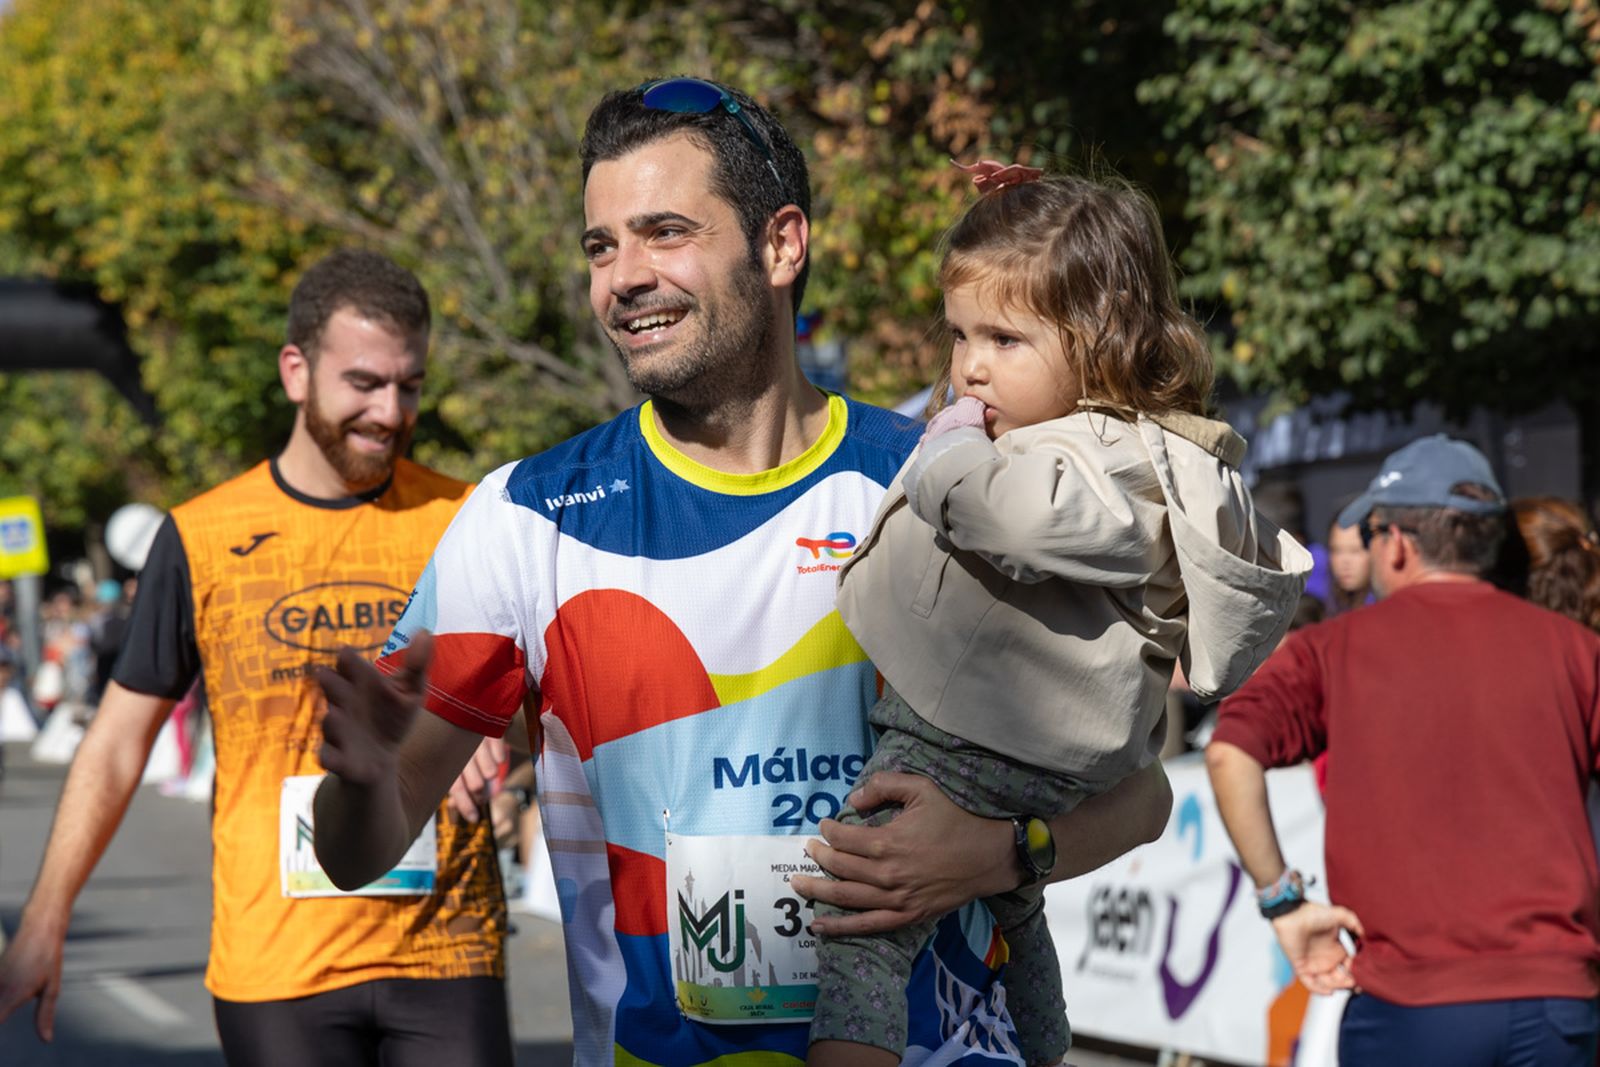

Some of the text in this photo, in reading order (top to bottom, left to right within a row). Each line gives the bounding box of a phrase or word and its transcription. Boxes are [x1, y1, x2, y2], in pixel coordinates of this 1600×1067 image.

[281, 600, 405, 634] GALBIS
[771, 791, 850, 828] 20
[771, 864, 799, 872] MEDIA
